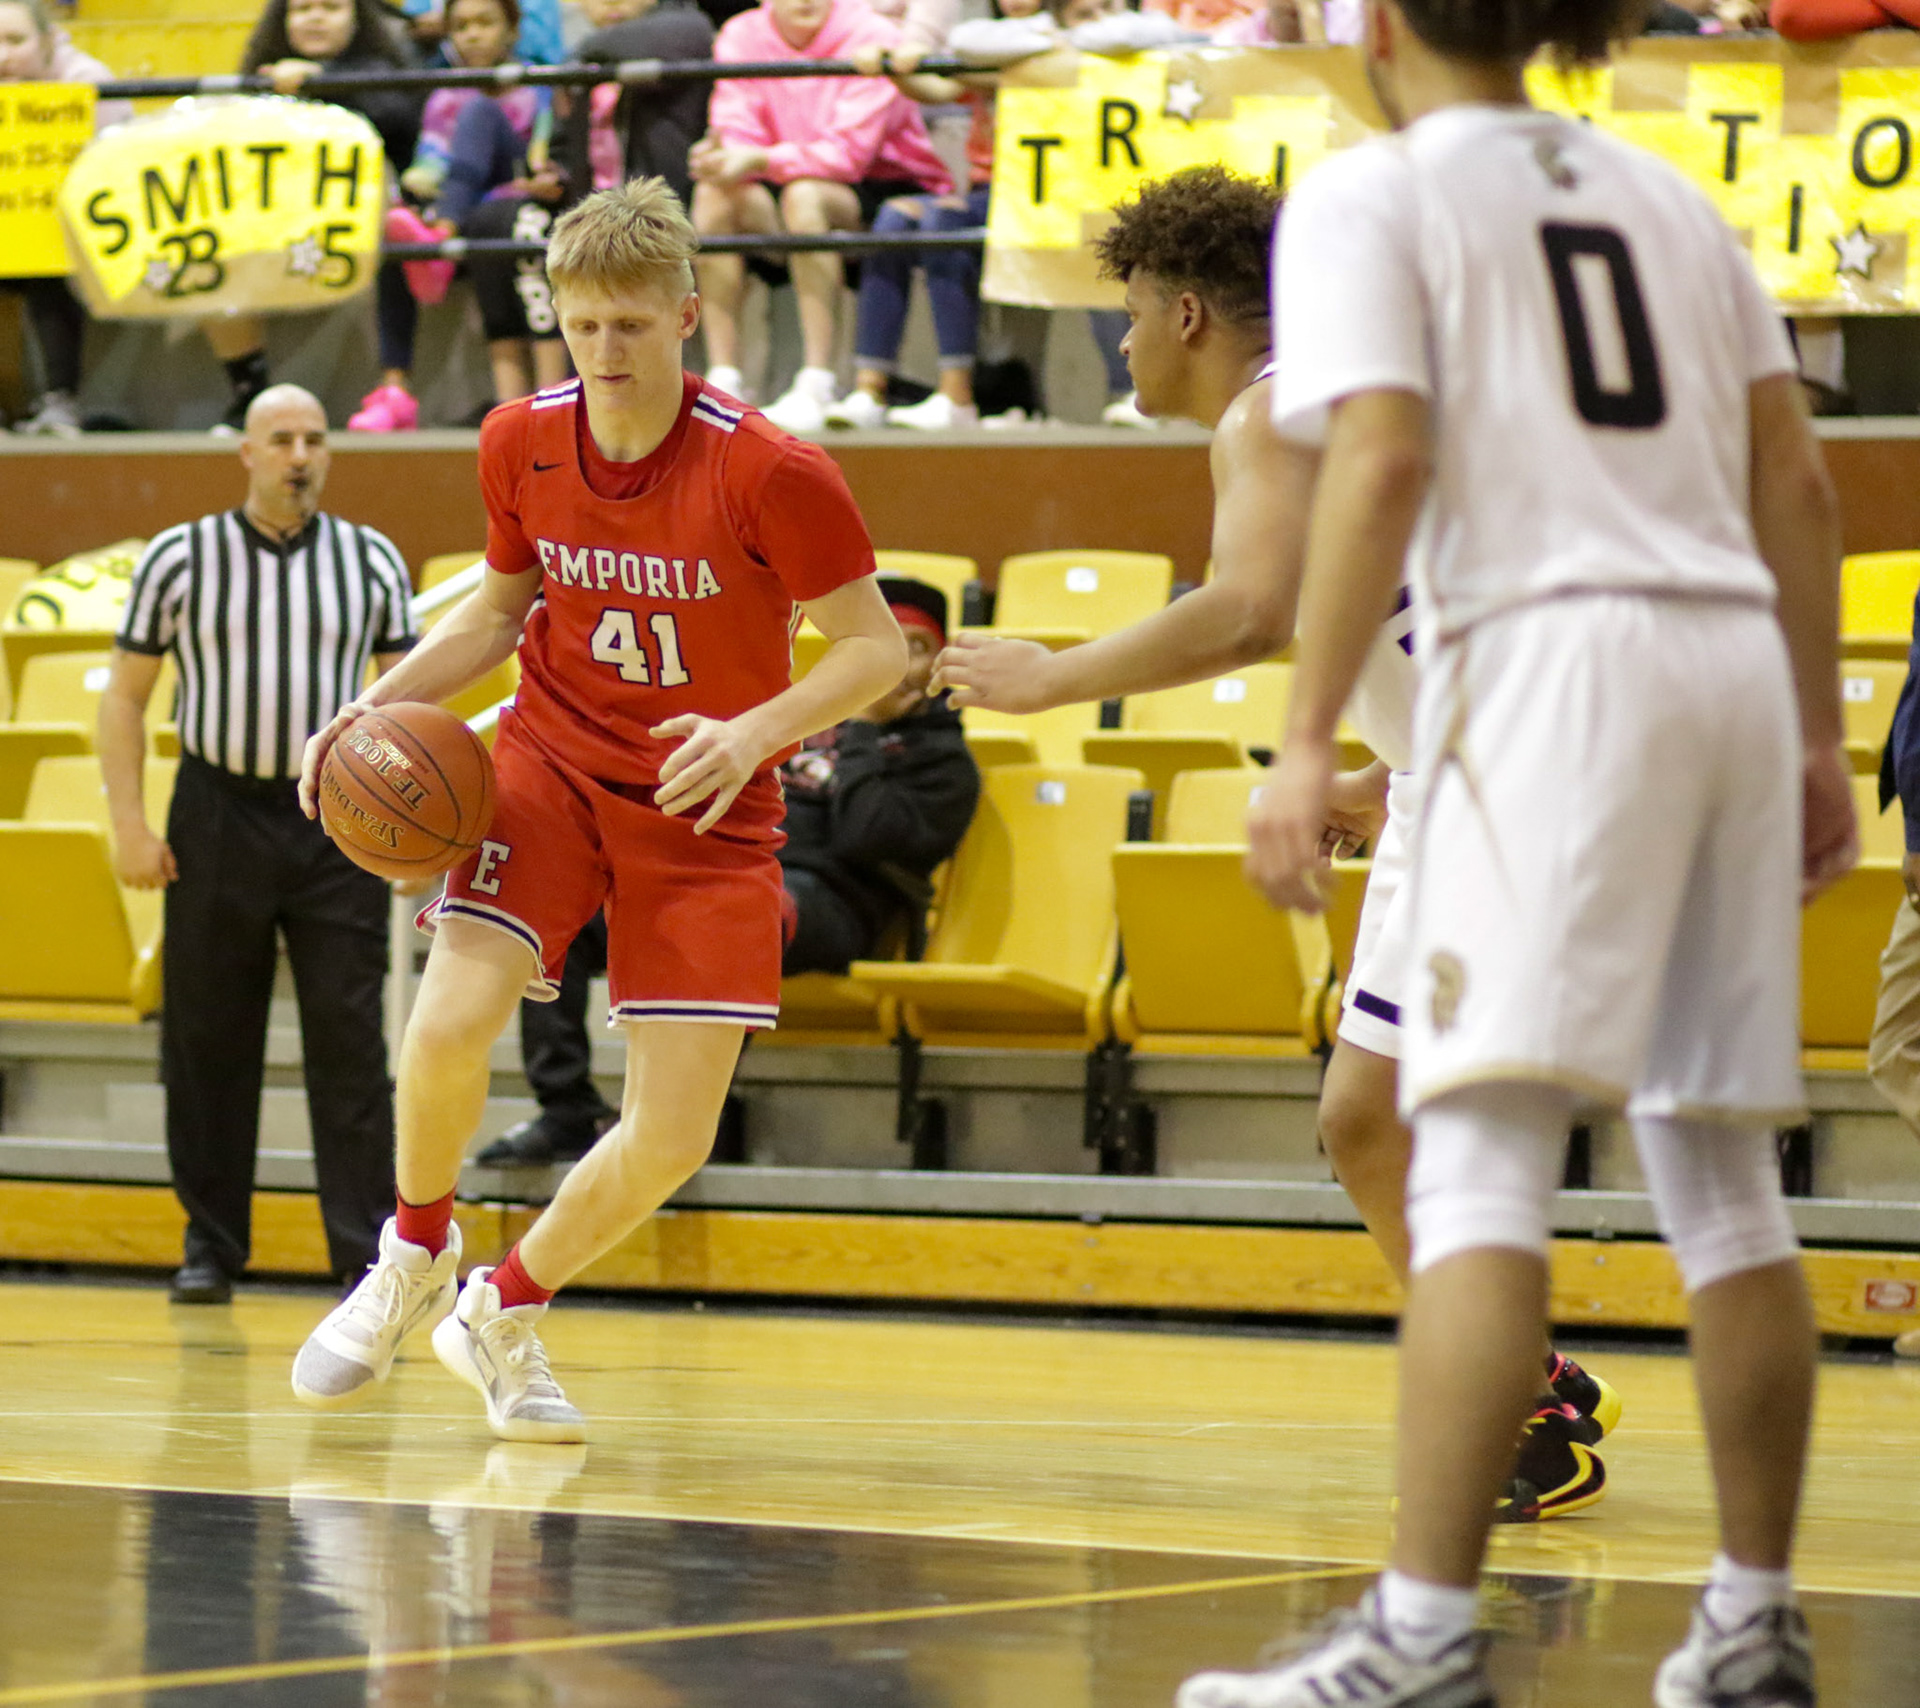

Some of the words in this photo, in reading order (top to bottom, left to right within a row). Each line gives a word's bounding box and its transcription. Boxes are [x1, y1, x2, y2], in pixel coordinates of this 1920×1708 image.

[87, 142, 361, 257] SMITH
[161, 227, 224, 297] 23
[324, 225, 356, 289] 5
[1538, 218, 1668, 429] 0
[536, 537, 722, 601] EMPORIA
[589, 606, 692, 688] 41
[378, 739, 411, 768] LEGACY
[322, 760, 405, 848] SPALDING
[469, 839, 511, 896] E
